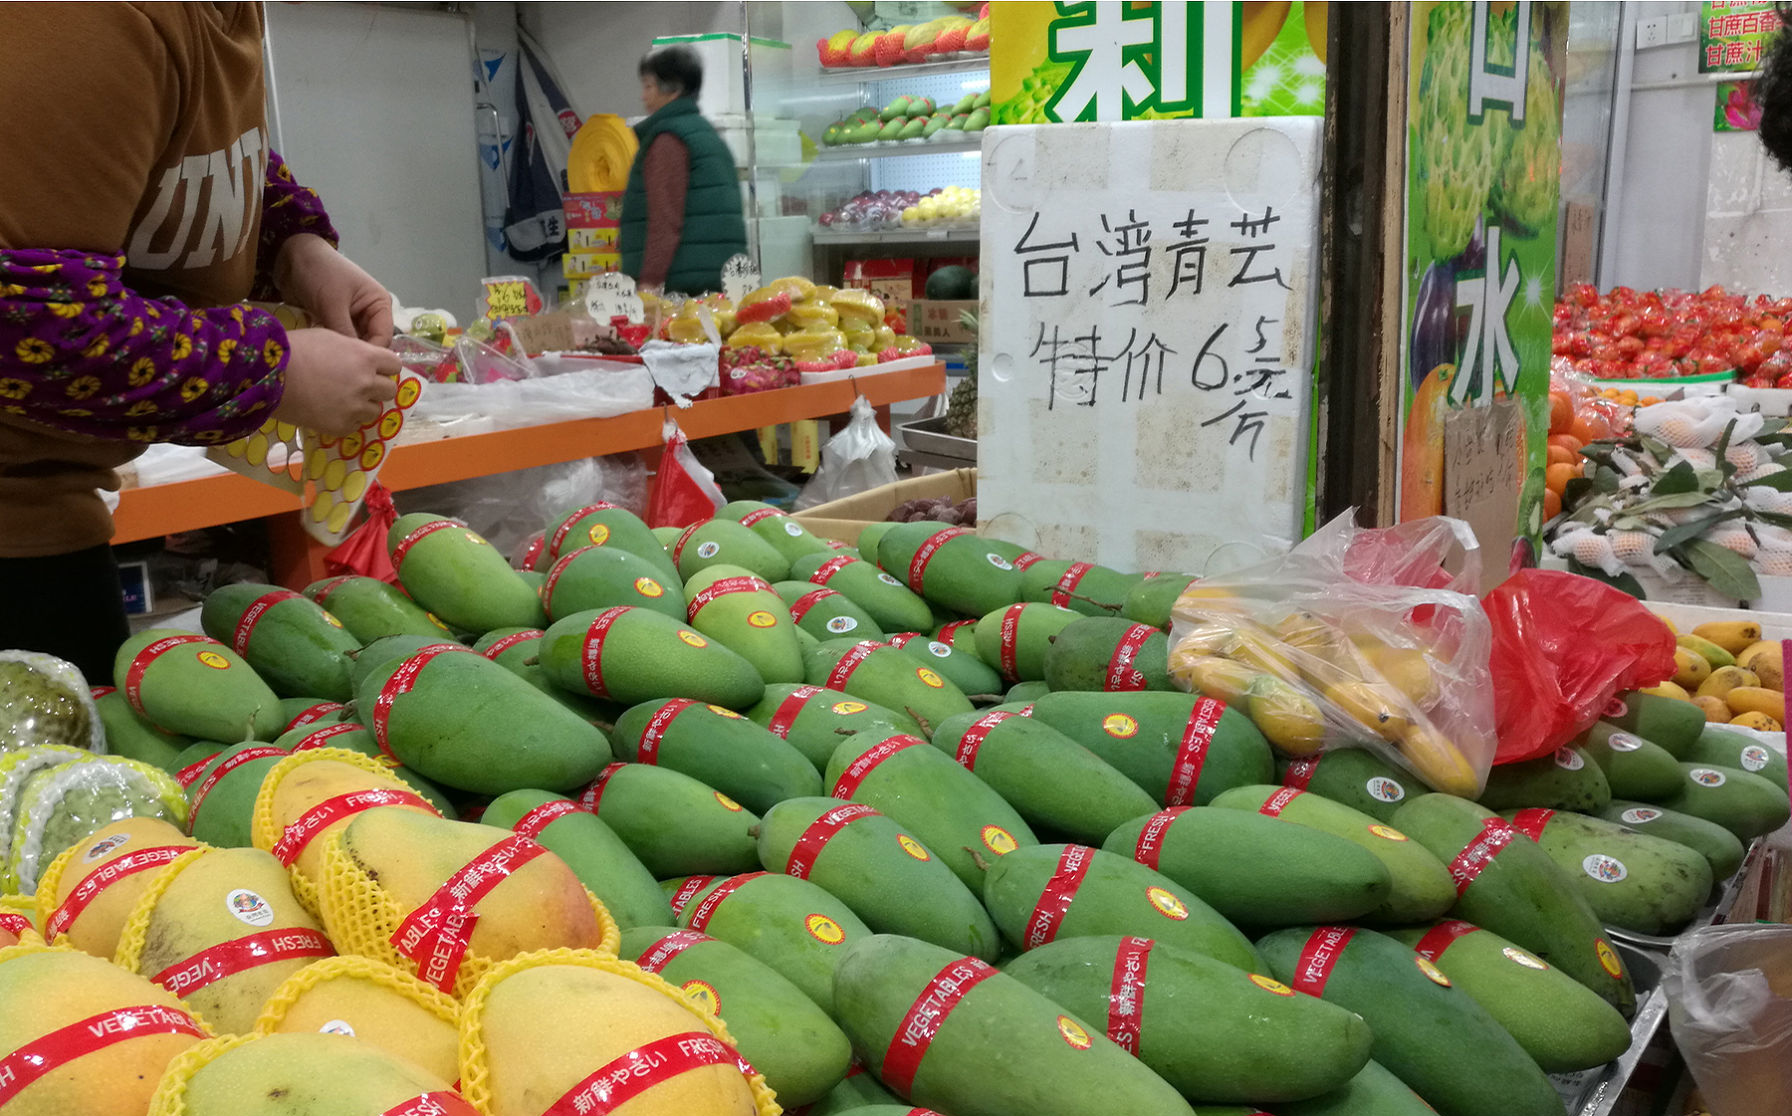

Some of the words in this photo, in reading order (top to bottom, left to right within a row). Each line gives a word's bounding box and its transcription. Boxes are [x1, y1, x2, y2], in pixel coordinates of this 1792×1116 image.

[1706, 40, 1763, 67] 甘蔗汁
[1014, 207, 1294, 307] 台湾青芸
[1142, 816, 1169, 850] FRESH
[449, 845, 521, 902] 新鮮やさい
[692, 886, 728, 930] FRESH
[271, 934, 323, 953] FRESH
[901, 964, 976, 1048] VEGETABLES
[1118, 950, 1143, 1017] 新鮮やさい
[572, 1049, 669, 1116] 新鮮やさい
